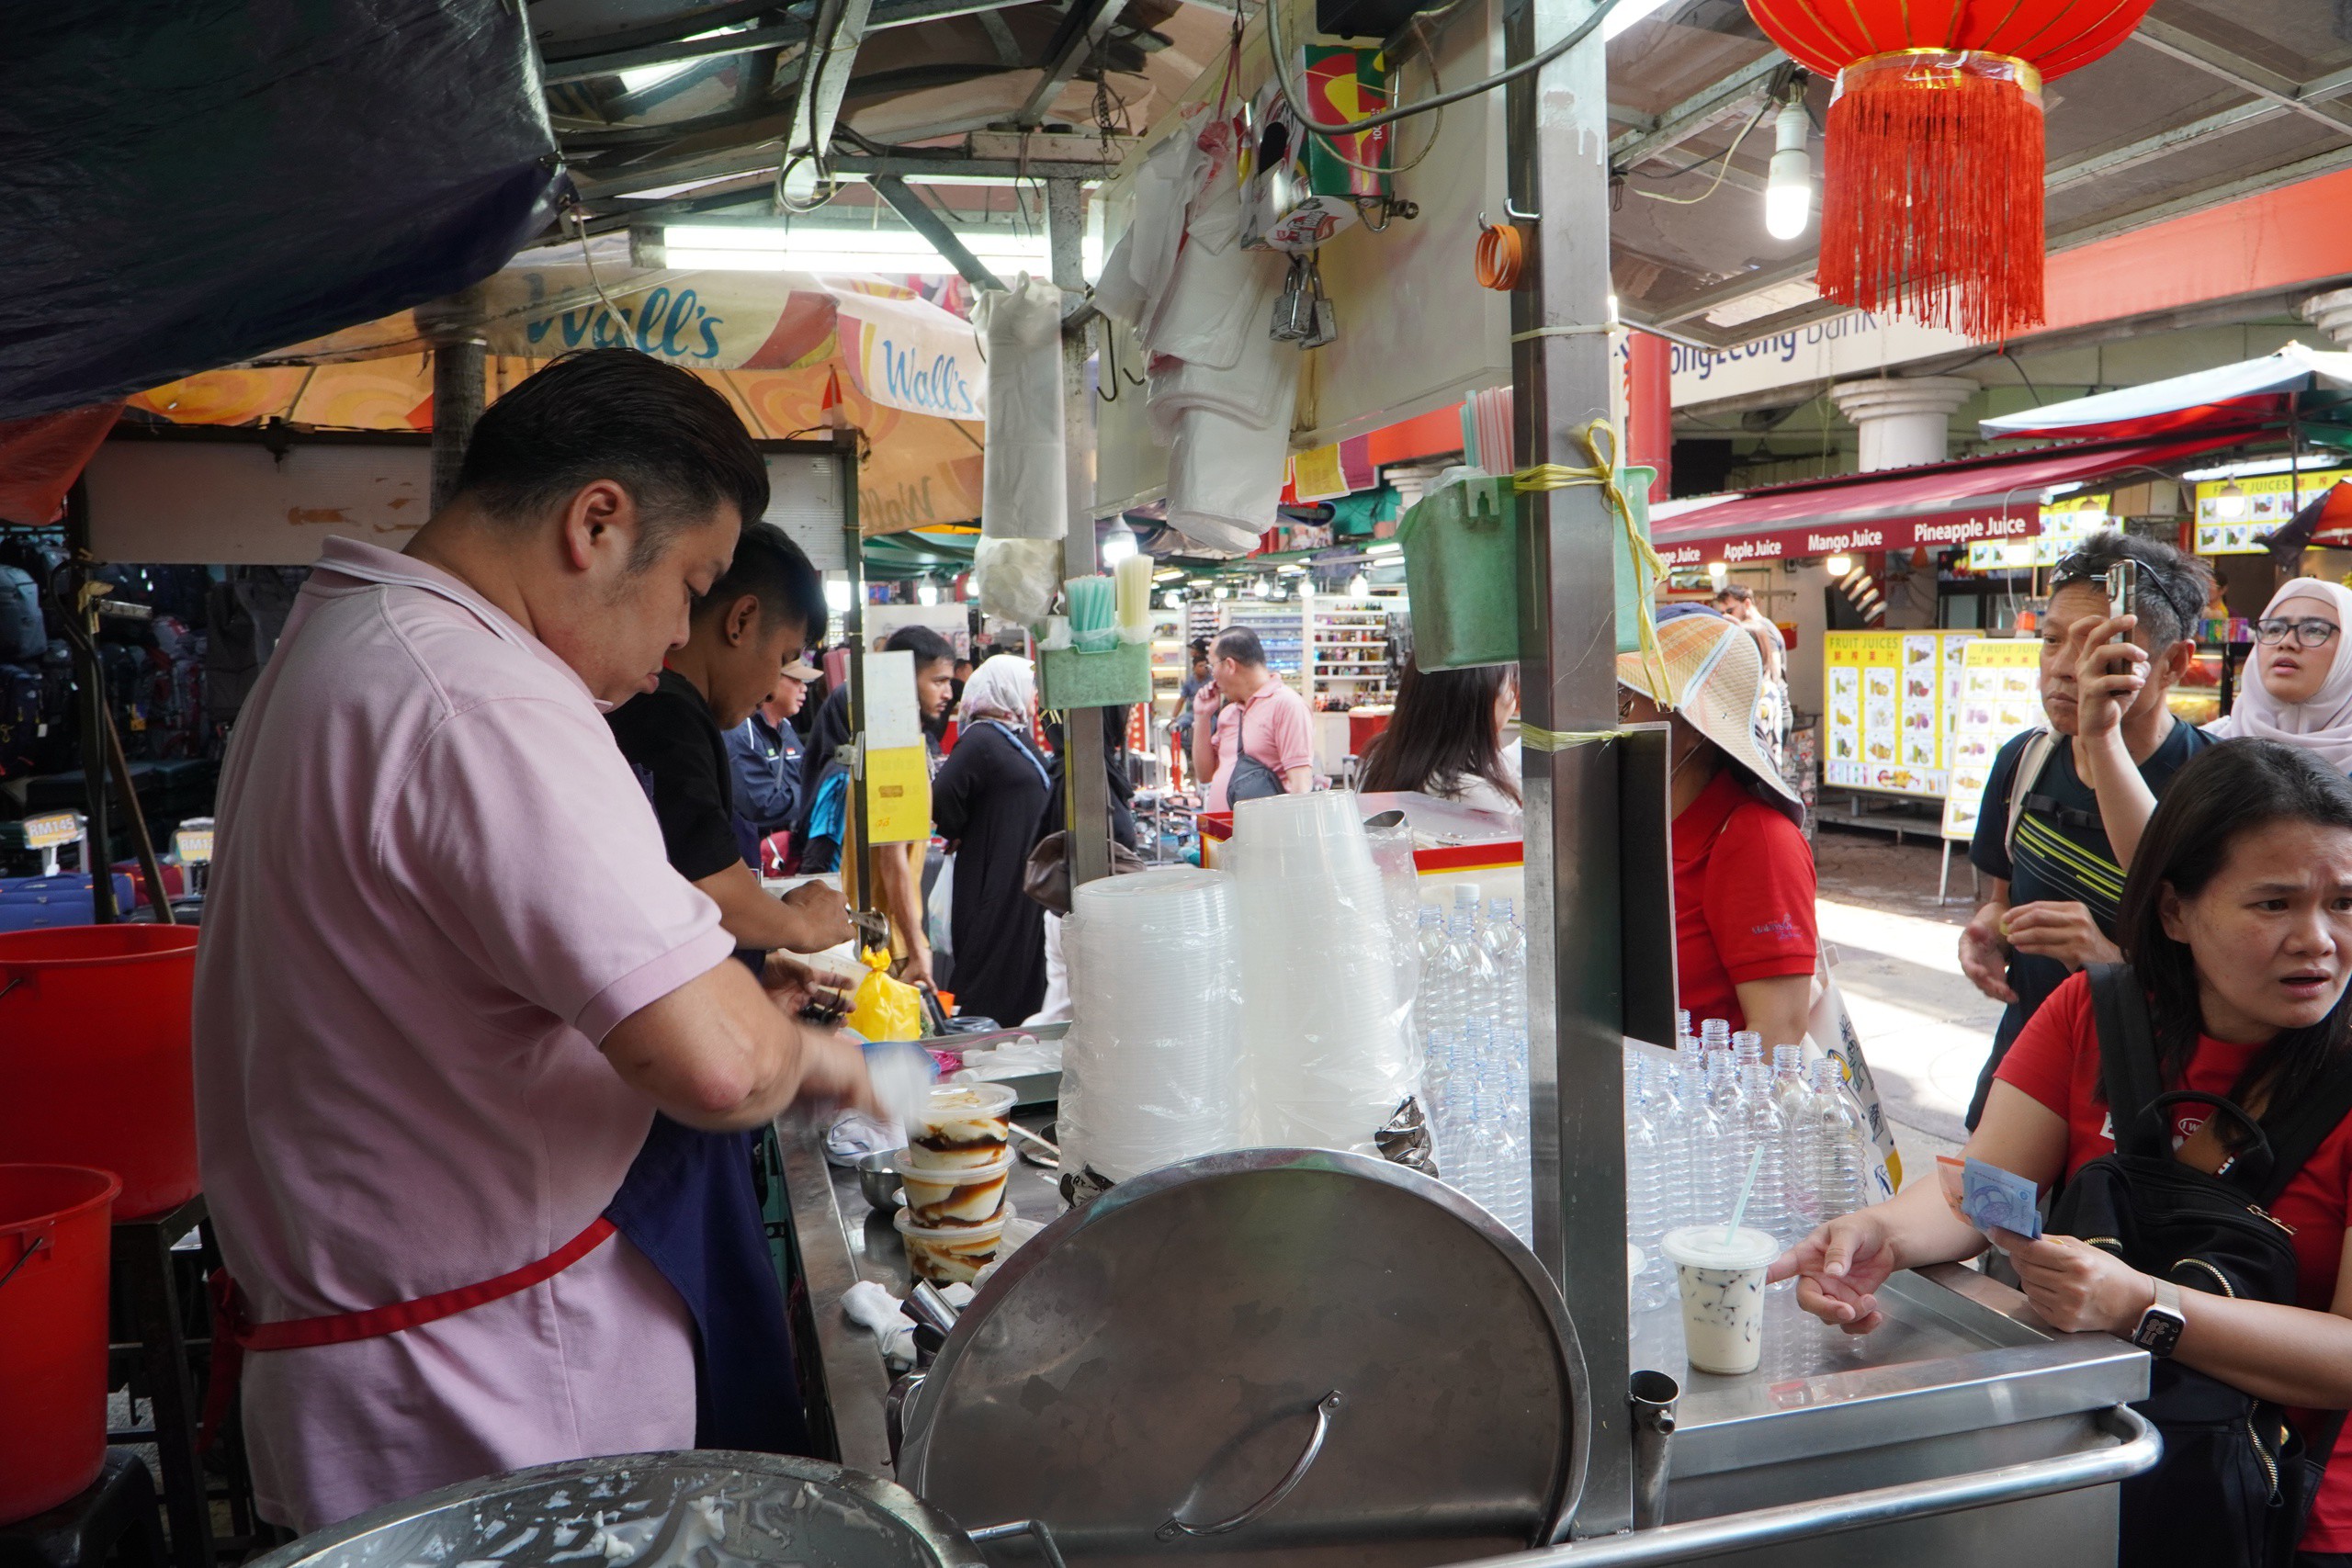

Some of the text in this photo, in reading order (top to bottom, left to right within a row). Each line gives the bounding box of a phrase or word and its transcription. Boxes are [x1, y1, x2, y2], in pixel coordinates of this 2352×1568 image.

[524, 273, 724, 359] Wall's
[883, 339, 975, 414] Wall's
[2250, 479, 2289, 492] JUICES
[1914, 515, 2027, 542] Pineapple Juice
[1723, 538, 1782, 562] Apple Juice
[1807, 528, 1883, 553] Mango Juice
[1677, 547, 1701, 563] Juice
[1830, 637, 1899, 649] FRUIT JUICES
[2018, 645, 2043, 654] JUIC
[28, 816, 75, 838] RM145
